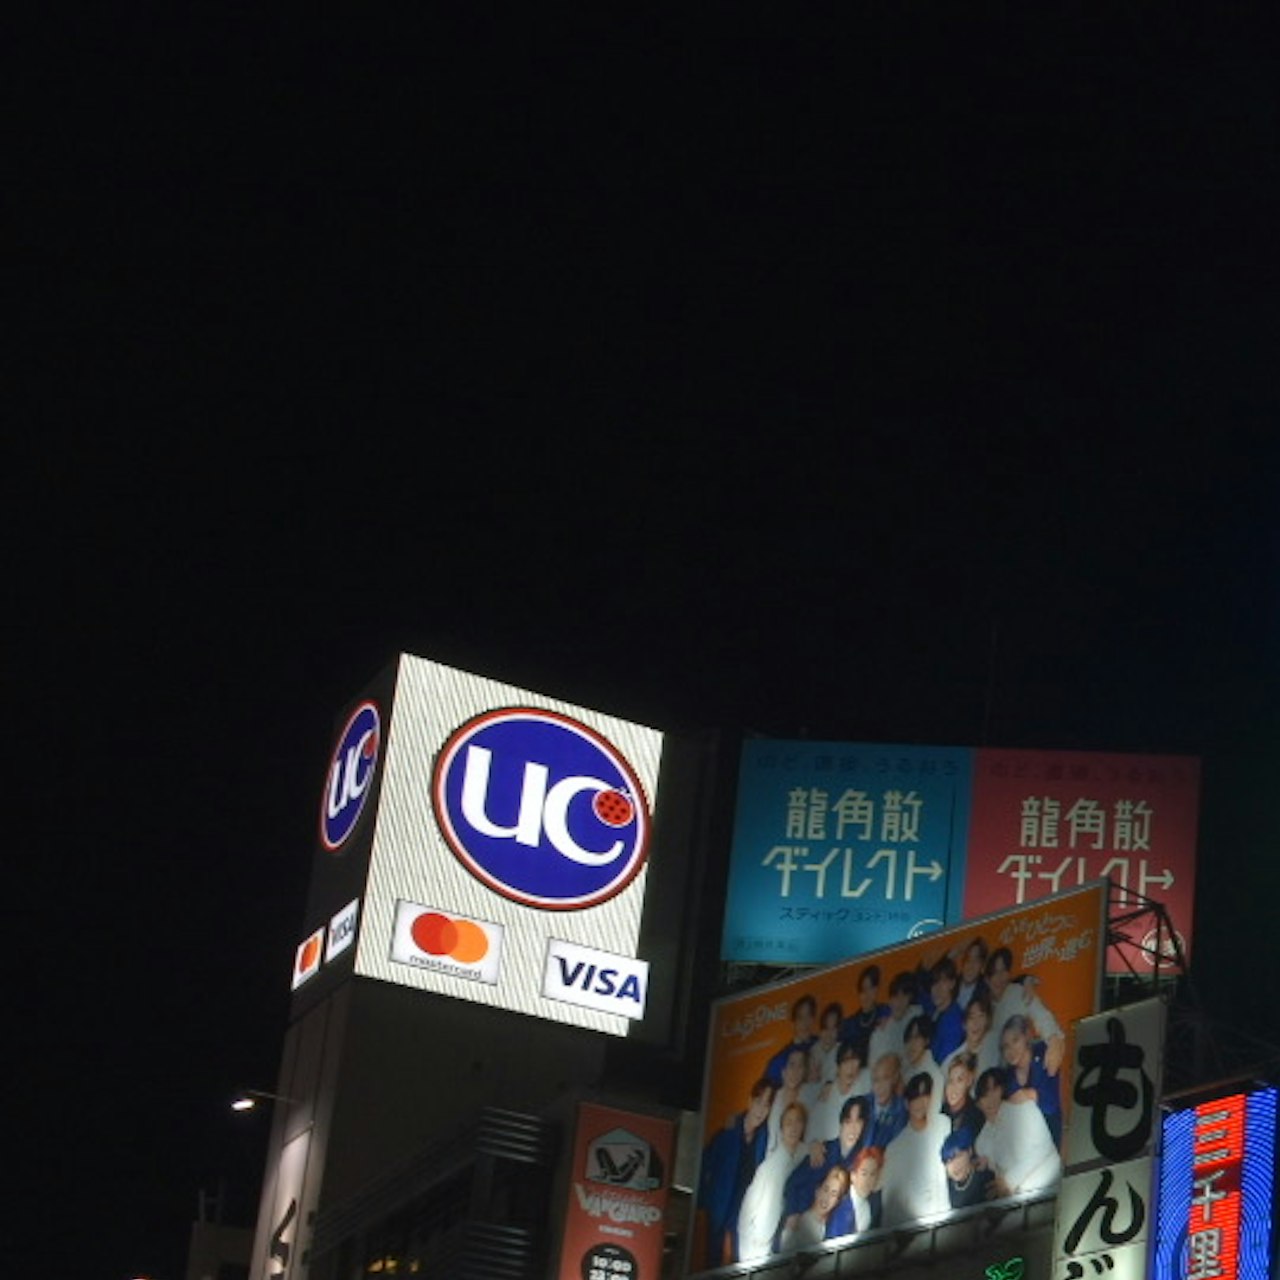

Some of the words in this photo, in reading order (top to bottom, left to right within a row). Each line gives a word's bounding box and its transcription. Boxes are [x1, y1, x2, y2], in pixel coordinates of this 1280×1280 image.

[328, 737, 377, 819] UC
[461, 744, 632, 866] UC
[785, 786, 922, 842] 龍角散
[1020, 796, 1153, 852] 龍角散
[761, 845, 943, 901] ダイレクト
[410, 955, 482, 980] mastercard
[553, 955, 642, 1003] VISA
